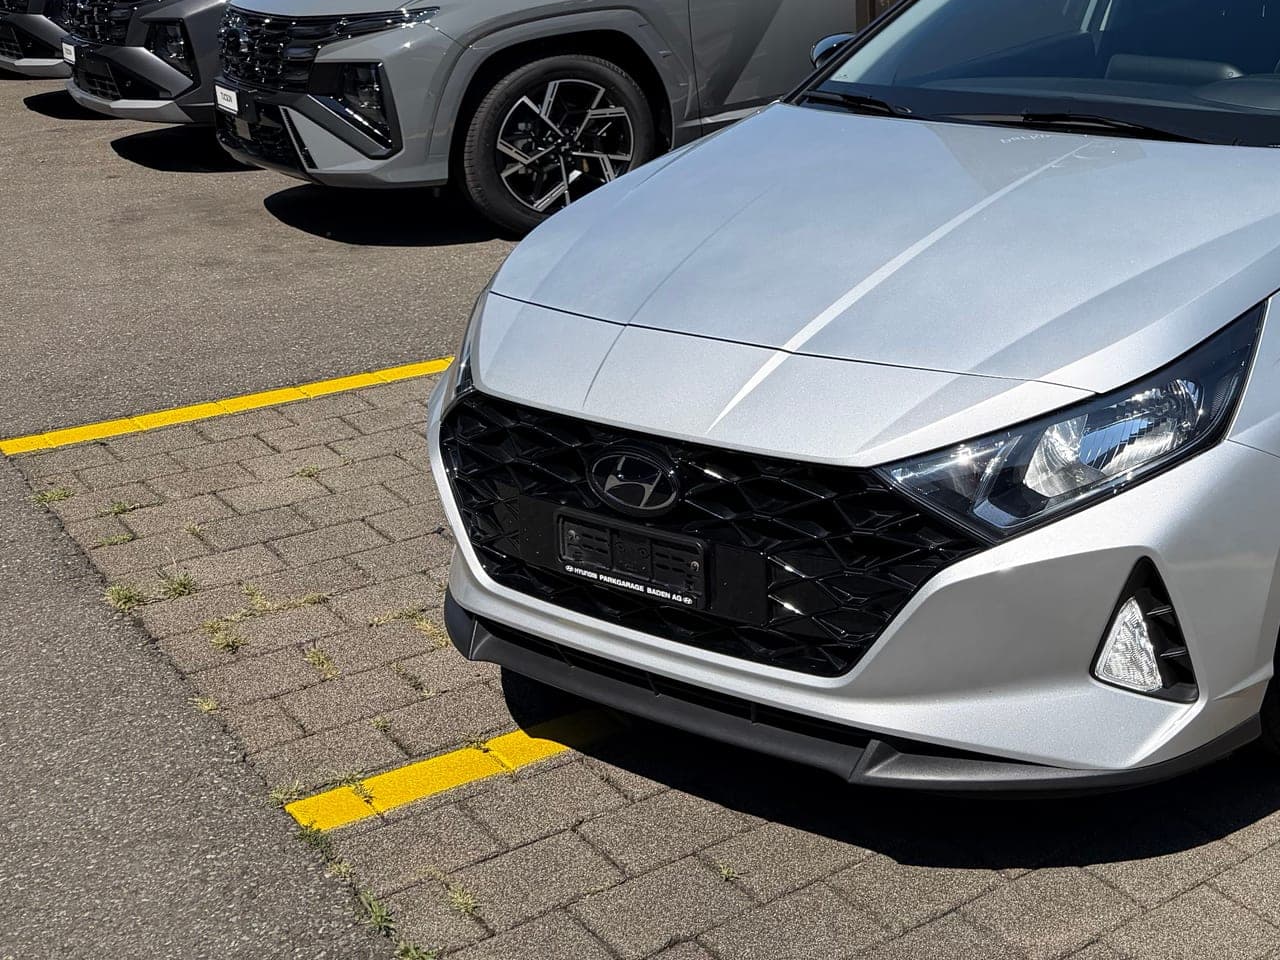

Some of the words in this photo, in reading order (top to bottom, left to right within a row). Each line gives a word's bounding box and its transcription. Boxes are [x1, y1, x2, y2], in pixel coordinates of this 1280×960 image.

[599, 575, 645, 592] PARKGARAGE
[646, 587, 671, 599] BADEN
[671, 593, 682, 602] AG
